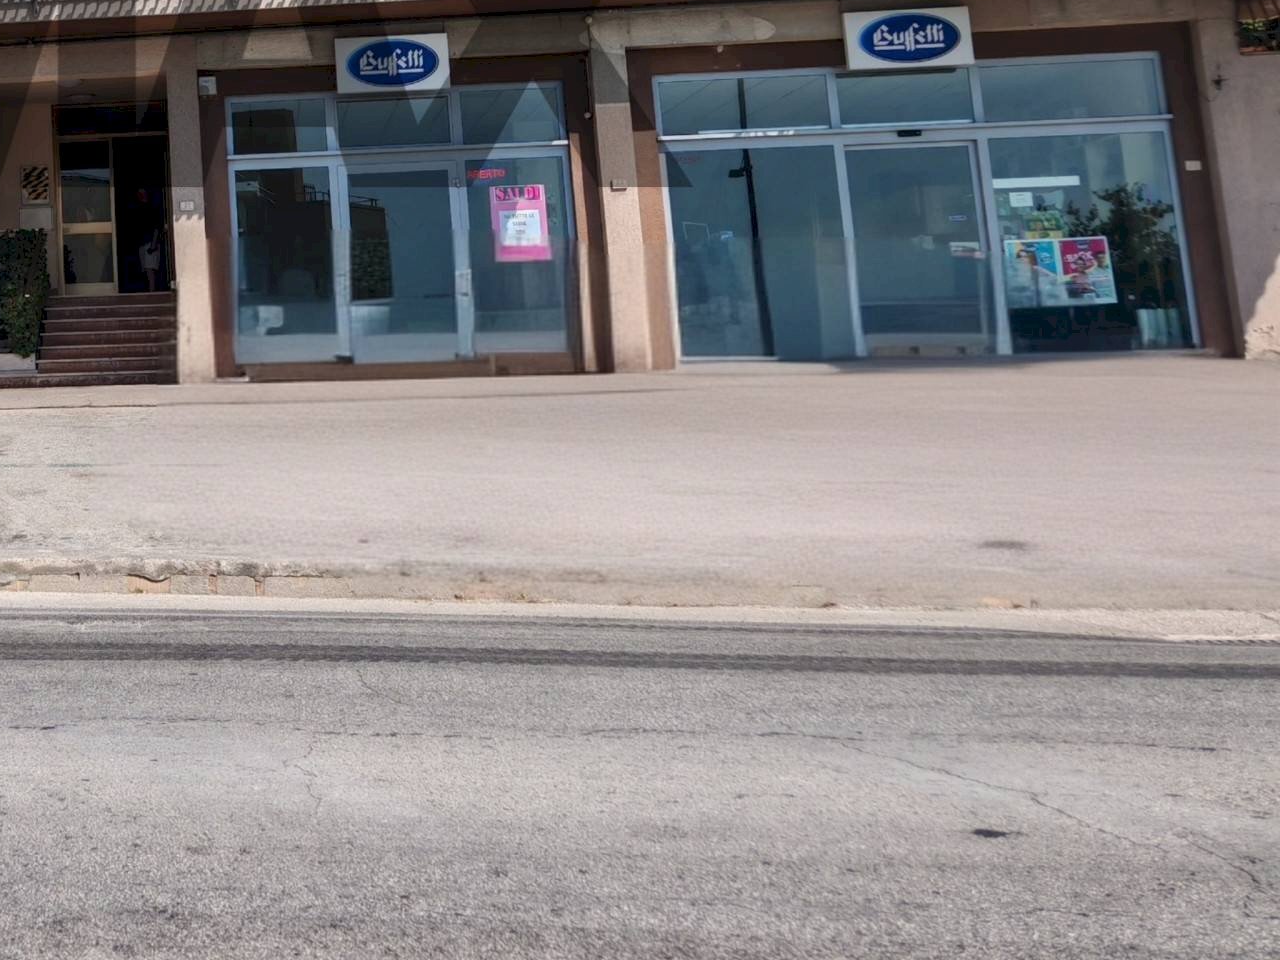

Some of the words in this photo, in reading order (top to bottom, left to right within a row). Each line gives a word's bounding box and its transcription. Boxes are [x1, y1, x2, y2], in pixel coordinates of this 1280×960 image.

[873, 23, 945, 51] Buffetti
[360, 48, 424, 76] Buffetti
[495, 187, 540, 200] SALDI
